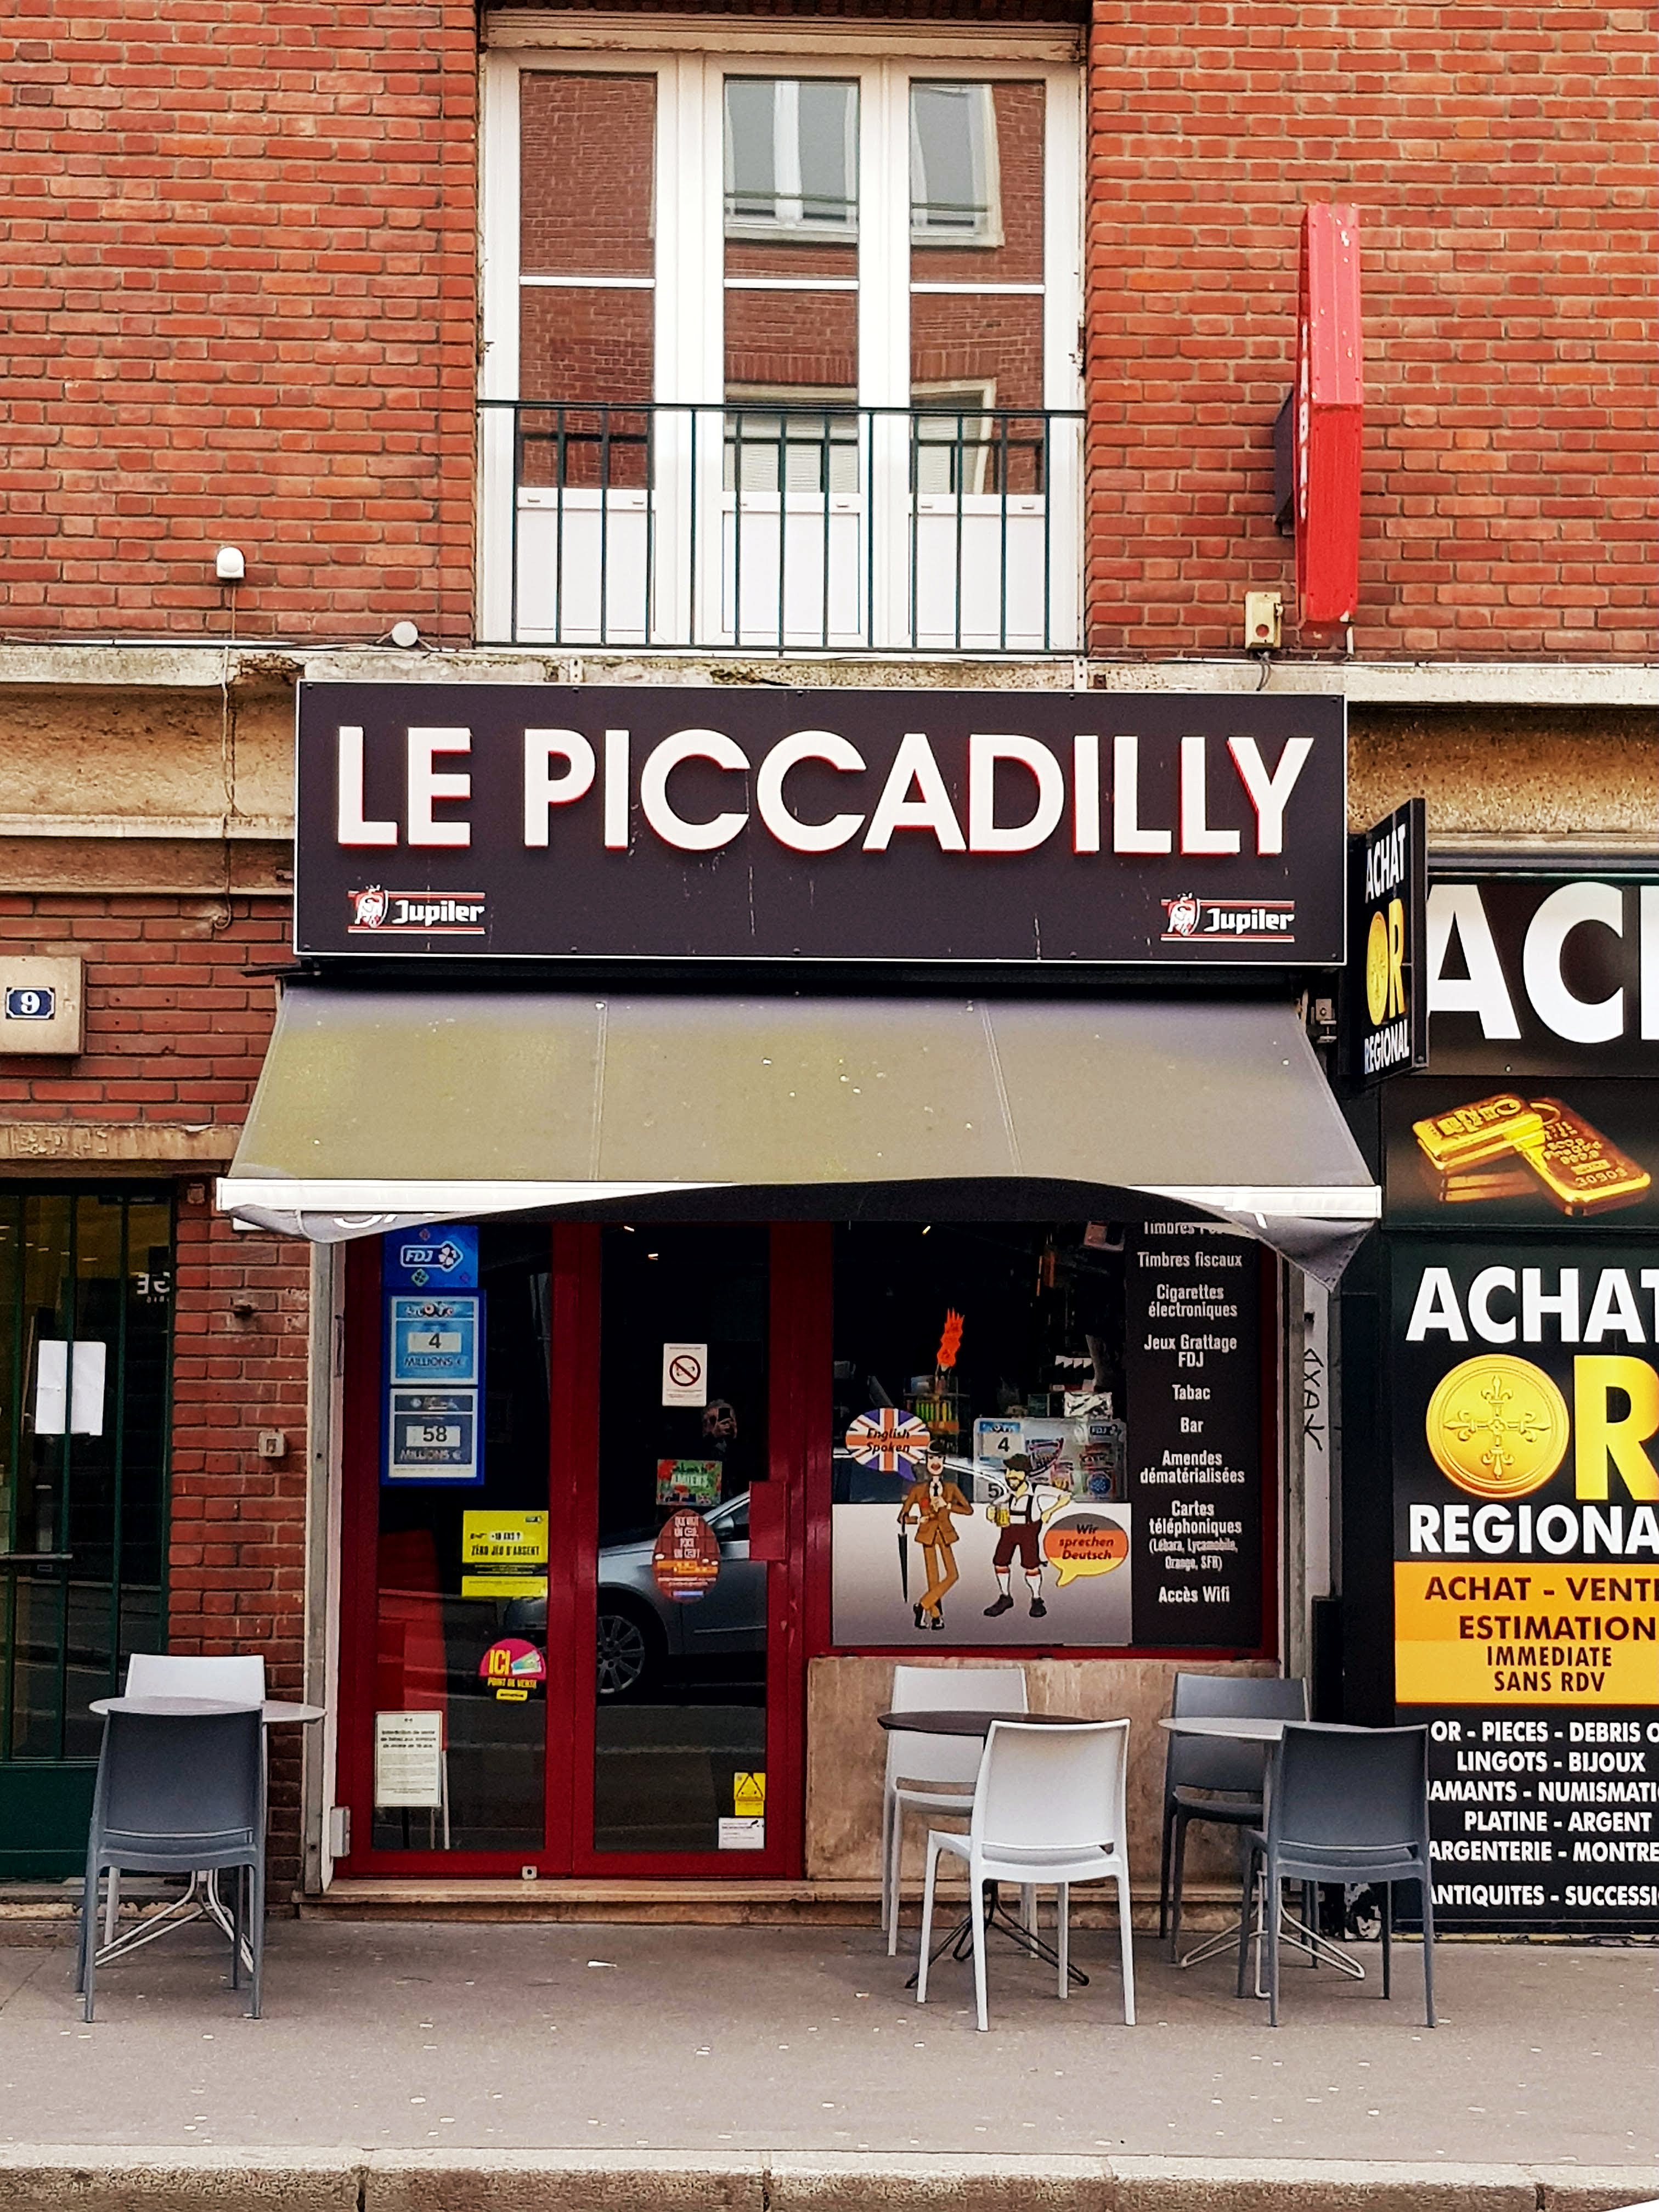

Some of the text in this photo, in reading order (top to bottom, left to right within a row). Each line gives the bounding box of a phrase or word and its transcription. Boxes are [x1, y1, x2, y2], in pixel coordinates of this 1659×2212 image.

[337, 726, 1315, 856] LE PICCADILLY
[1365, 823, 1407, 904] ACHAT
[391, 899, 486, 927] Jupiler
[1203, 907, 1295, 935] Jupiler
[1427, 881, 1659, 1043] AC
[21, 991, 41, 1014] 9
[1364, 1019, 1410, 1075] REGIONAL
[405, 1249, 433, 1262] FDJ
[1137, 1251, 1243, 1267] Timbres fiscaux
[1156, 1284, 1224, 1302] Cigarettes
[1148, 1301, 1238, 1321] électroniques
[428, 1333, 442, 1348] 4
[1144, 1334, 1237, 1353] Jeux Grattage
[1178, 1351, 1204, 1368] FDJ
[1172, 1384, 1211, 1401] Tabac
[422, 1425, 447, 1442] 58
[866, 1427, 910, 1442] English
[1180, 1417, 1204, 1433] Bar
[866, 1442, 910, 1454] Spoken
[997, 1437, 1010, 1453] 4
[1161, 1450, 1222, 1466] Amendes
[1140, 1467, 1245, 1483] dématérialisées
[1171, 1500, 1215, 1516] Cartes
[1076, 1523, 1099, 1534] Wir
[1149, 1518, 1243, 1538] téléphoniques
[1059, 1537, 1114, 1549] sprechen
[1062, 1549, 1111, 1560] Deutsch
[1158, 1585, 1230, 1603] Accès Wifi
[1425, 1576, 1532, 1601] ACHAT
[1459, 1616, 1656, 1641] ESTIMATION
[488, 1649, 511, 1676] ICI
[1487, 1646, 1612, 1667] IMMEDIATE
[1494, 1671, 1605, 1692] SANS RDV
[1430, 1720, 1462, 1742] OR
[1482, 1721, 1548, 1742] PIECES
[1569, 1722, 1641, 1743] DEBRIS
[1457, 1751, 1548, 1772] LINGOTS
[1568, 1751, 1646, 1773] BIJOUX
[1464, 1810, 1548, 1832] PLATINE
[1567, 1811, 1652, 1832] ARGENT
[1429, 1840, 1552, 1861] ARGENTERIE
